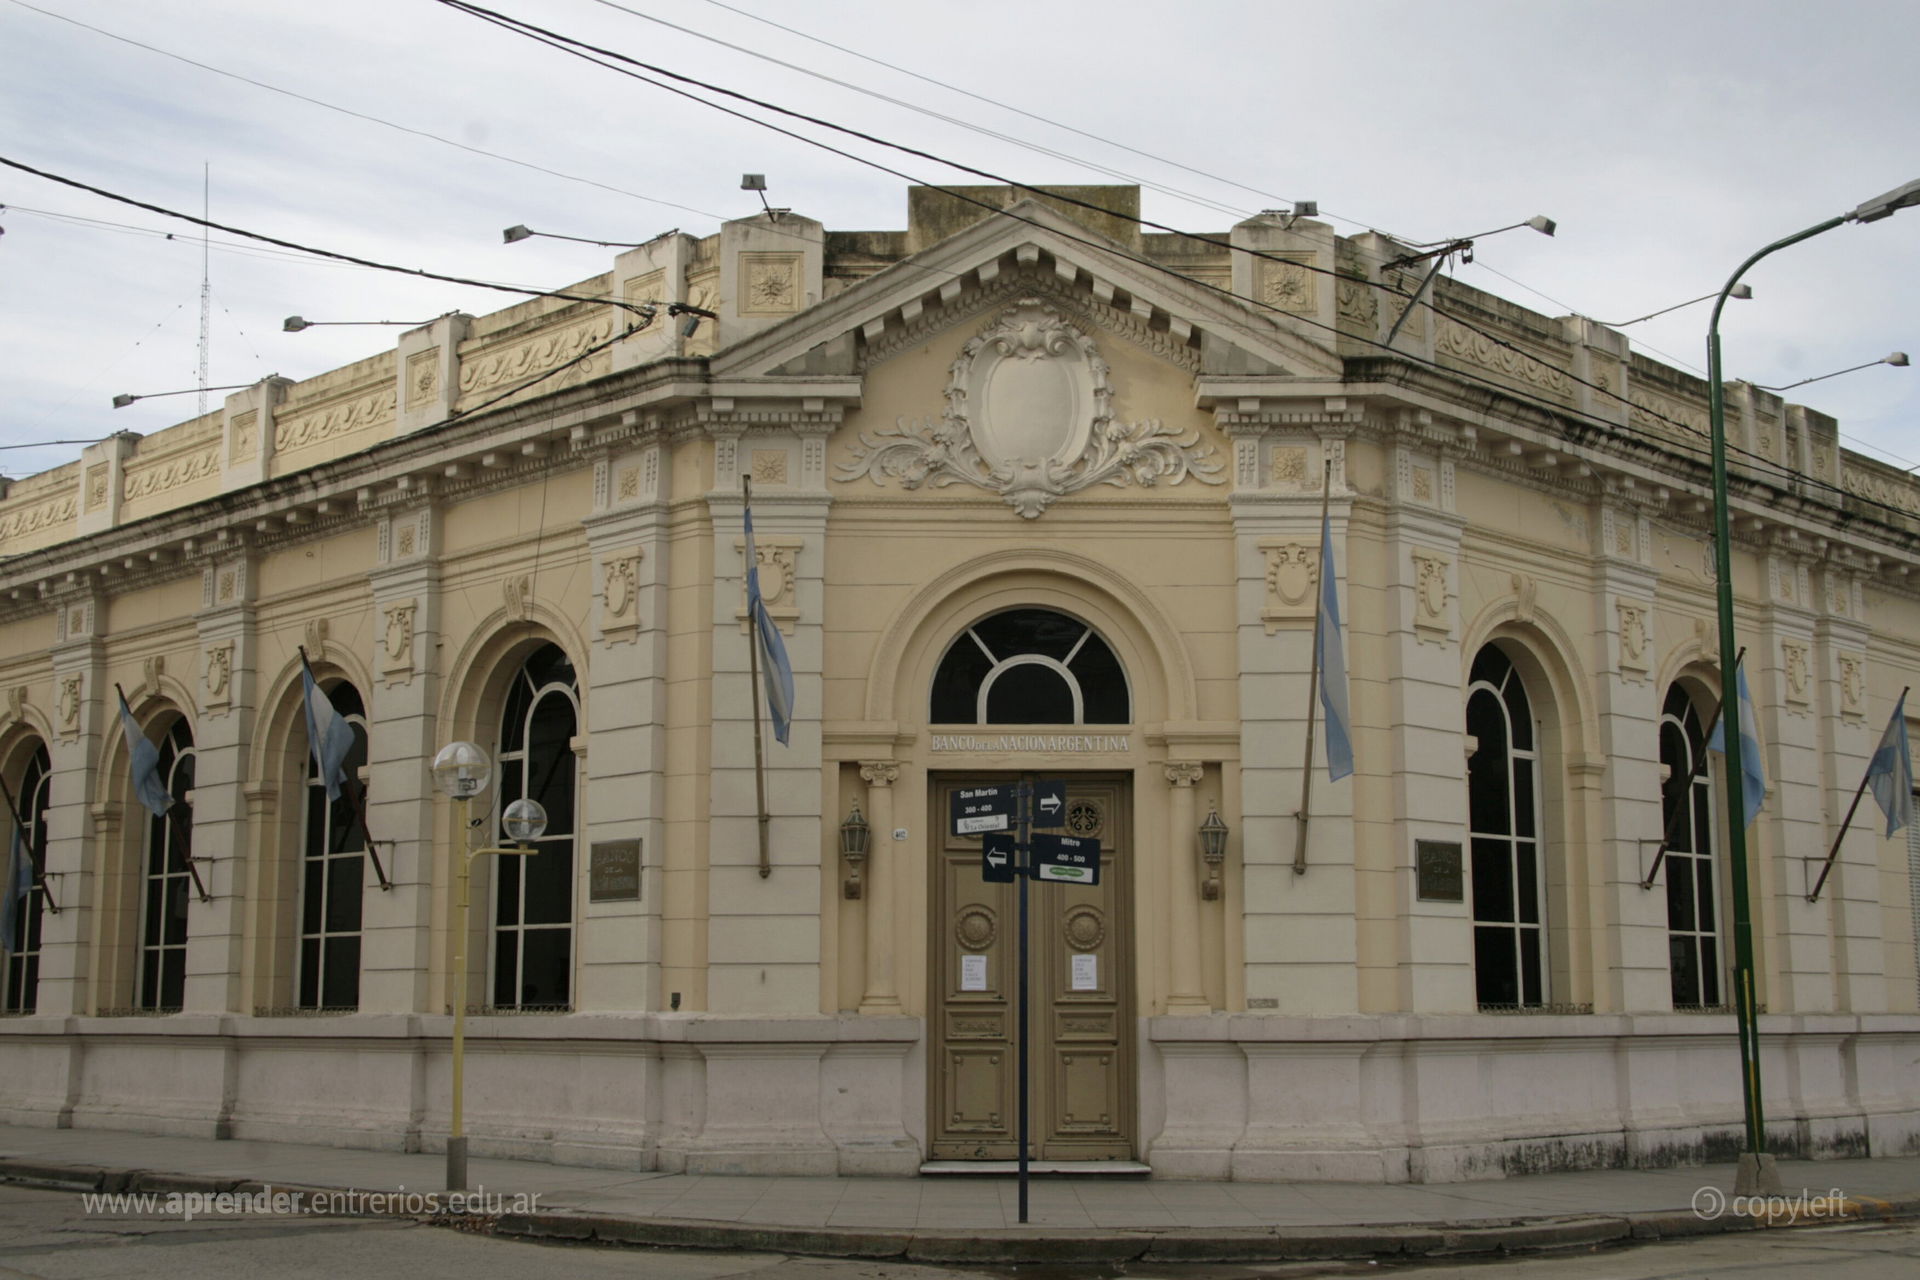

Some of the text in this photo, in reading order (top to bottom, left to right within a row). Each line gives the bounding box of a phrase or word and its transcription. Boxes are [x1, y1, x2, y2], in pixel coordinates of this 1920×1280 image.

[931, 735, 976, 751] BANCO
[1000, 735, 1047, 751] NACION
[1048, 735, 1130, 751] ARGENTINA
[960, 790, 974, 799] San
[980, 803, 993, 812] 400
[1061, 837, 1081, 847] Mitre
[1056, 853, 1069, 862] 400
[1073, 855, 1086, 863] 500
